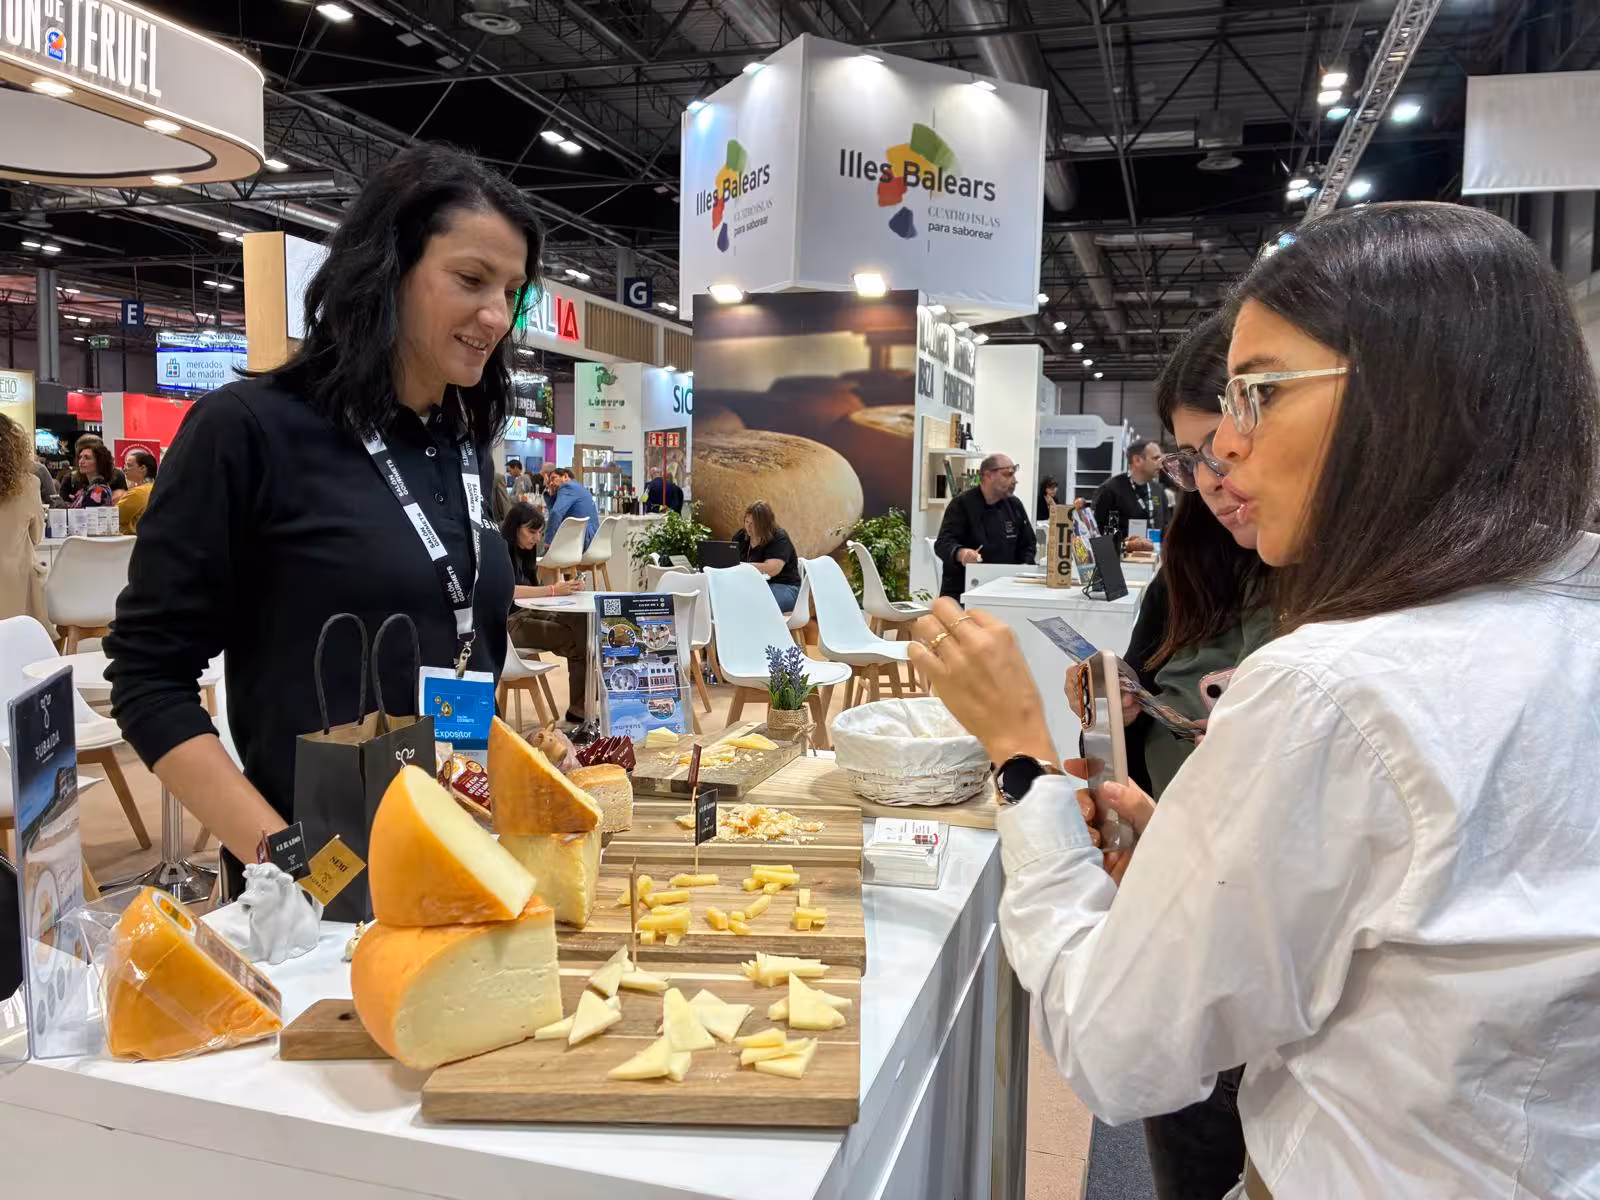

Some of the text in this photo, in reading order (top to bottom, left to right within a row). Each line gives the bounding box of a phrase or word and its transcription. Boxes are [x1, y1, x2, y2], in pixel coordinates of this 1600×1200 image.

[71, 0, 162, 98] TERUEL
[840, 149, 996, 201] Illes Balears
[696, 164, 771, 216] Illes Balears
[927, 206, 1001, 228] CUATRO ISLAS
[928, 222, 994, 240] para saborear
[629, 281, 648, 305] G
[126, 303, 138, 325] E
[514, 285, 579, 341] ALIA
[186, 360, 223, 369] mercados
[186, 370, 225, 378] de madrid
[385, 458, 410, 497] GOURMETS
[388, 473, 404, 498] SALÓN
[416, 511, 441, 548] GOURMETS
[419, 525, 436, 550] SALÓN
[446, 565, 466, 603] GOURMETS
[446, 580, 460, 604] SALÓN
[35, 729, 60, 761] SUBAIDA
[434, 728, 473, 739] Expositor
[330, 856, 349, 873] SEMI
